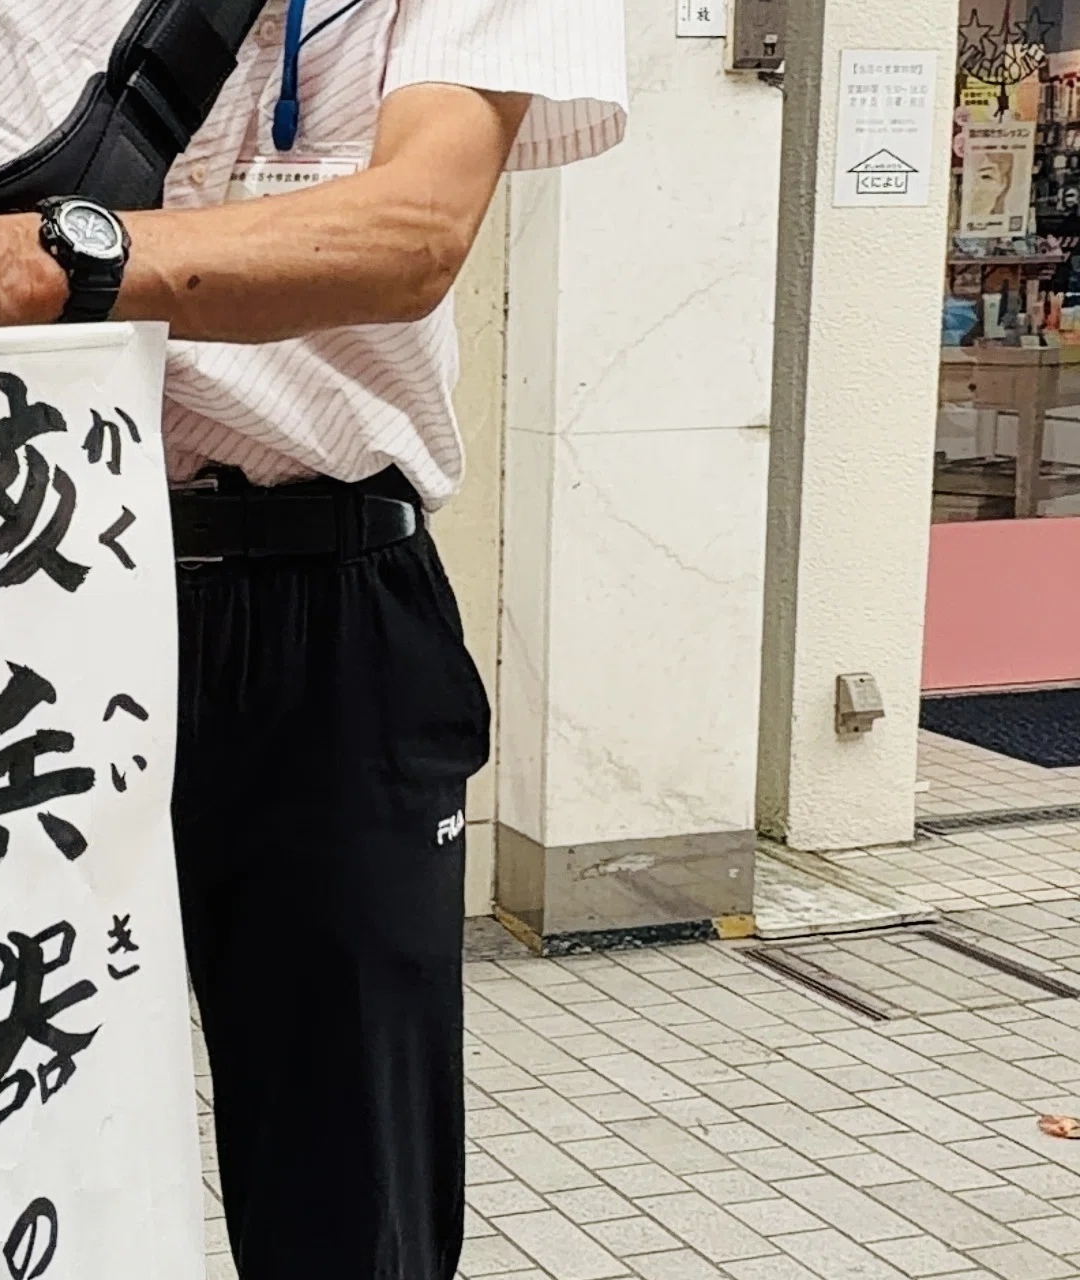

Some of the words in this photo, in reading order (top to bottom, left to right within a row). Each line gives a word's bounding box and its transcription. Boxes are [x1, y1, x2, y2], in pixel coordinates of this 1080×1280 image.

[860, 175, 905, 189] くによし
[82, 407, 142, 569] かく
[103, 694, 148, 792] へい
